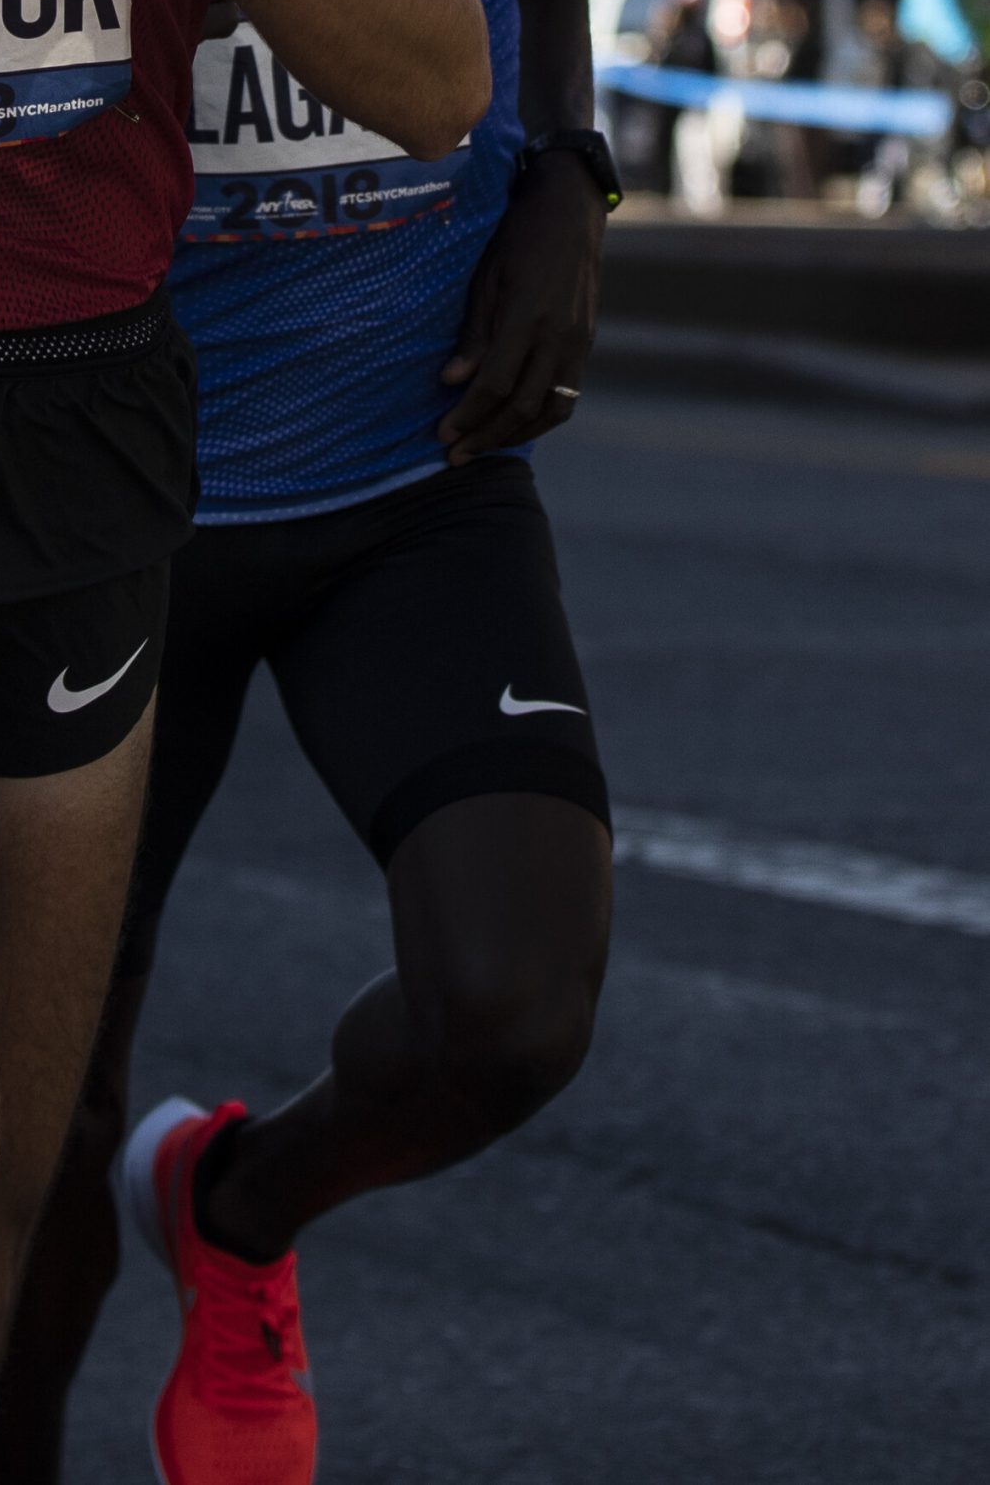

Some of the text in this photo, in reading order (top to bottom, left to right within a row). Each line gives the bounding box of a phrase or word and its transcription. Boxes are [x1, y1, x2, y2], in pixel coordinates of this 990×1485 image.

[187, 45, 346, 144] LAG
[220, 170, 384, 230] 2018
[339, 180, 451, 205] #TCSNYCMarathon
